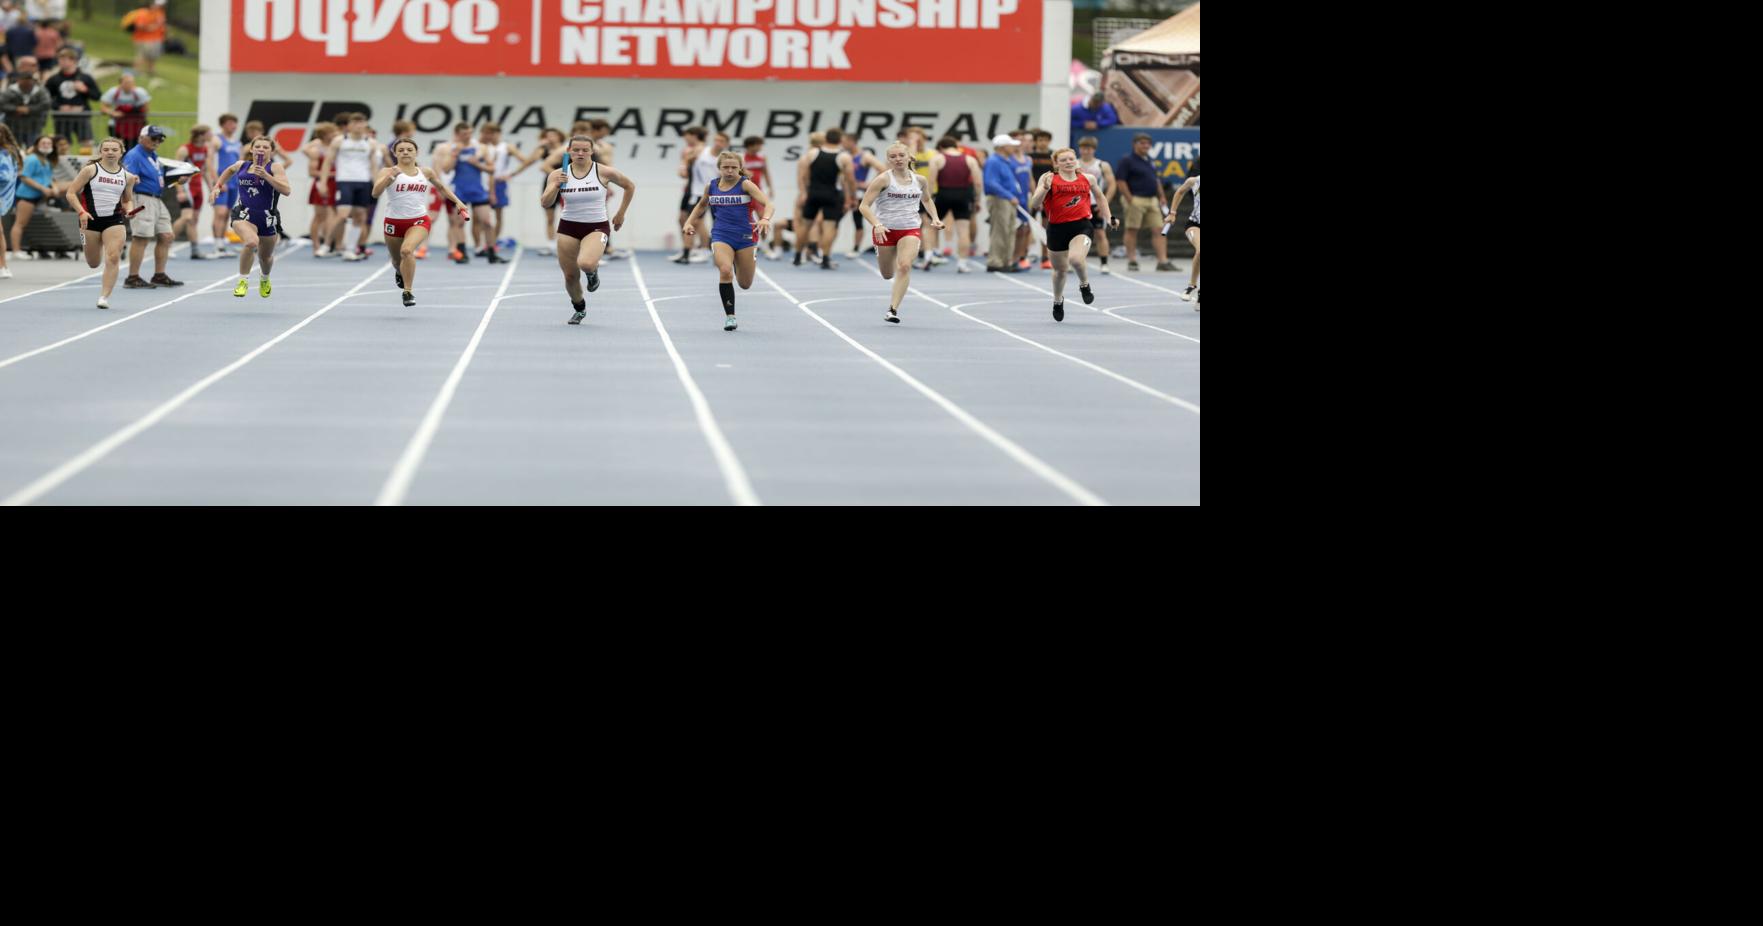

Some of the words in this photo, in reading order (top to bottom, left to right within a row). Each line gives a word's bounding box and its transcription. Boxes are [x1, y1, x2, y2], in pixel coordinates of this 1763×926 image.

[560, 0, 1018, 30] CHAMPIONSHIP
[559, 26, 851, 69] NETWORK
[395, 103, 547, 134] IOWA
[569, 106, 749, 138] FARM
[764, 110, 1030, 142] BUREAU
[395, 183, 406, 192] LE
[386, 225, 393, 234] 6
